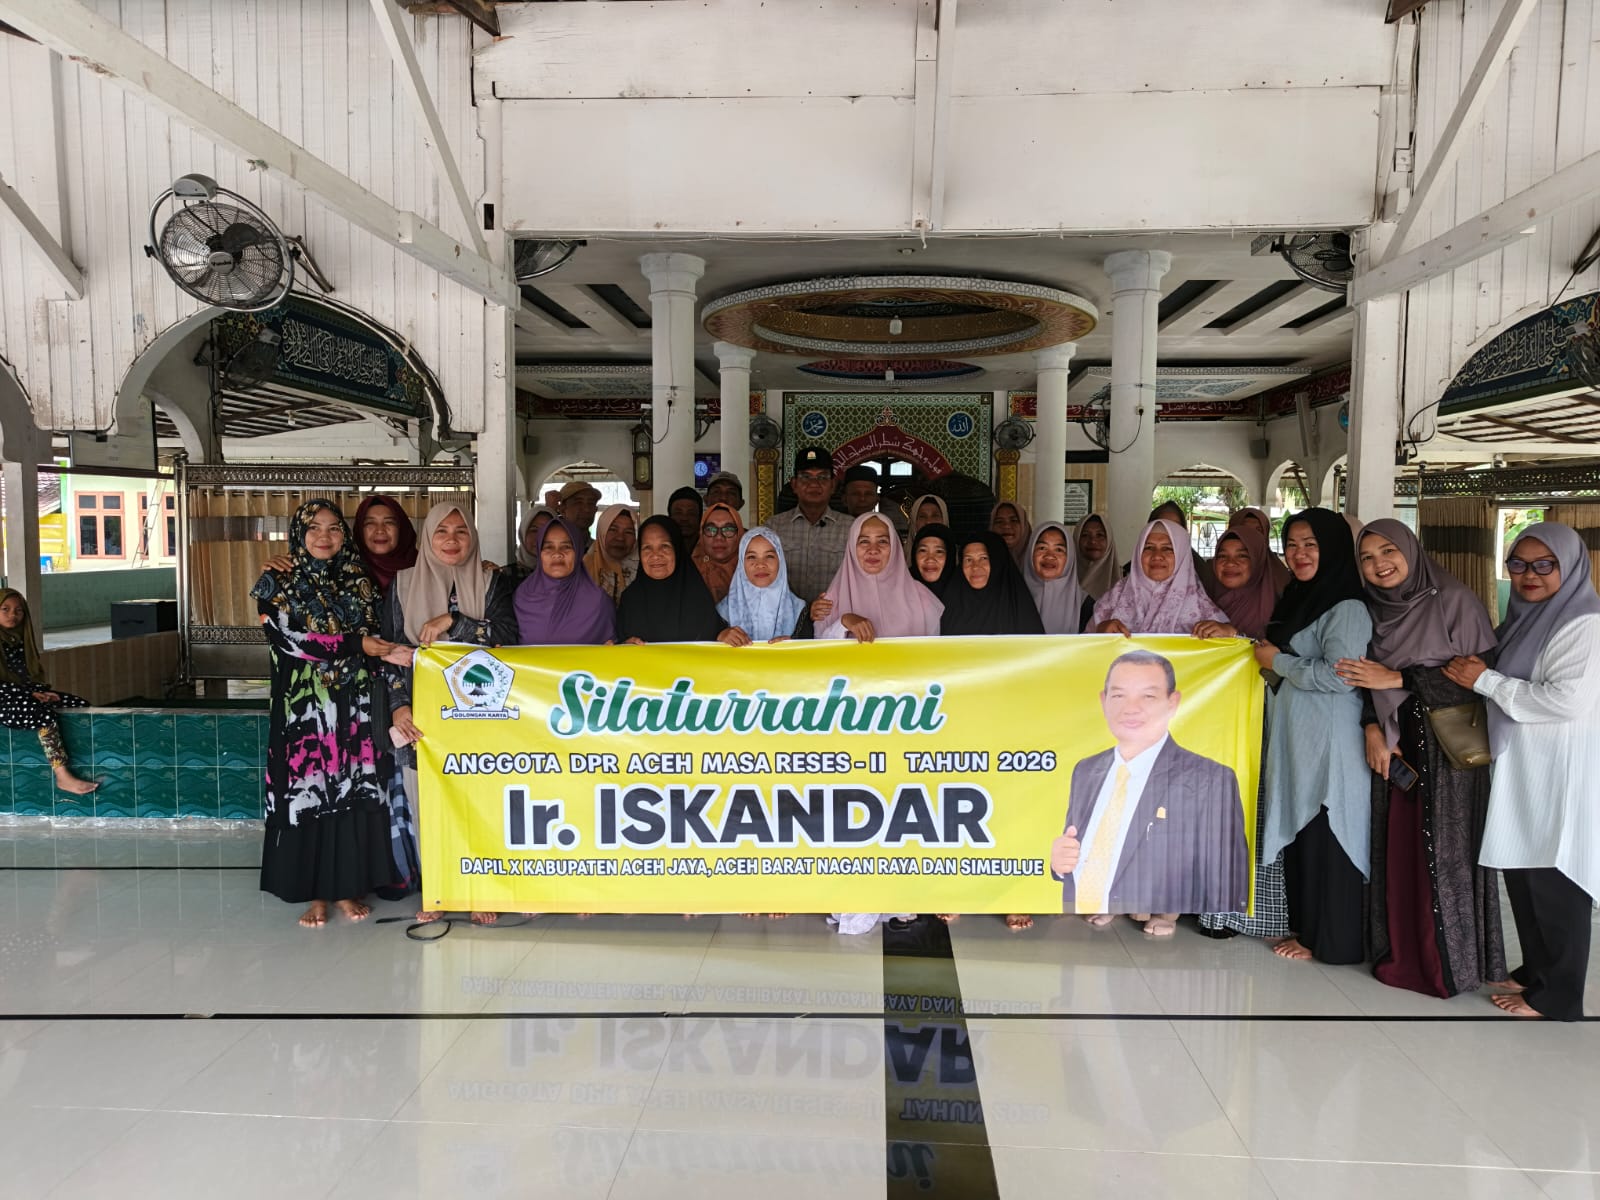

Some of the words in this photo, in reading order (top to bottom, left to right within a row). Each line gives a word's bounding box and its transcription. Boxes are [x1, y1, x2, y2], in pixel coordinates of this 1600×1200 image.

[950, 415, 970, 433] الله
[550, 673, 945, 736] Silaturrahmi
[443, 752, 562, 775] ANGGOTA
[569, 753, 619, 774] DPR
[626, 753, 693, 774] ACEH
[701, 752, 772, 774] MASA
[904, 751, 989, 774] TAHUN
[997, 751, 1057, 773] 2026
[508, 787, 577, 846] Ir.
[599, 786, 991, 845] ISKANDAR
[461, 858, 507, 875] DAPIL
[508, 859, 521, 875] X
[522, 859, 618, 876] KABUPATEN
[620, 859, 664, 876] ACEH
[667, 858, 713, 878] JAYA,
[714, 858, 759, 875] ACEH
[761, 857, 815, 875] BARAT
[816, 857, 875, 875] NAGAN
[877, 857, 920, 875] RAYA
[921, 858, 957, 876] DAN
[959, 858, 1045, 876] SIMEULUE
